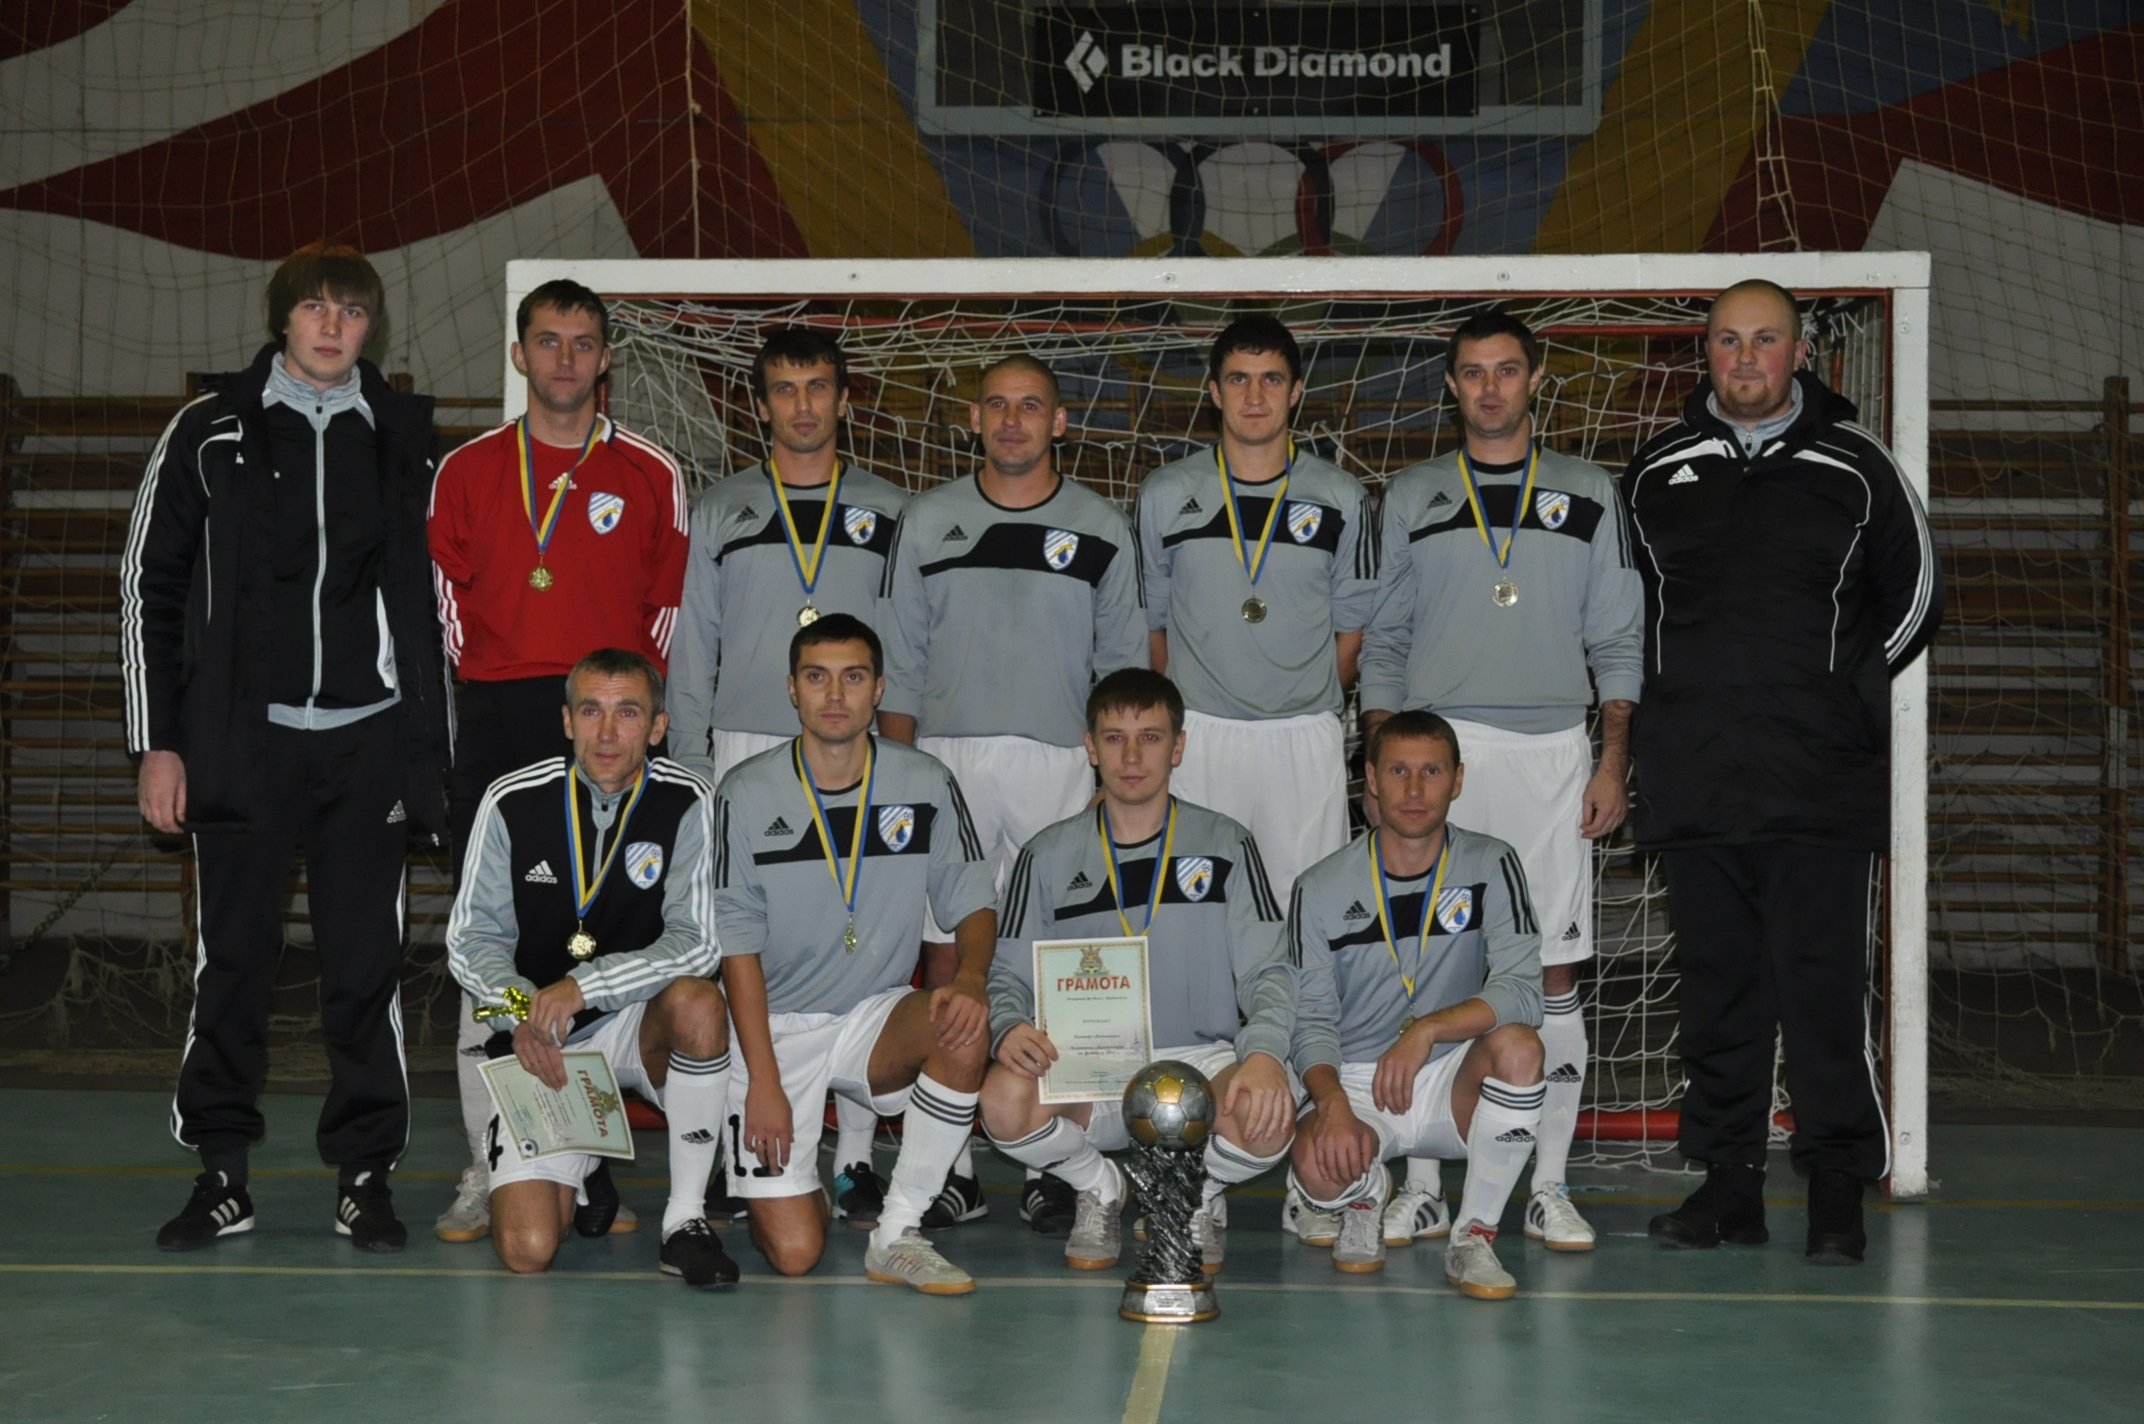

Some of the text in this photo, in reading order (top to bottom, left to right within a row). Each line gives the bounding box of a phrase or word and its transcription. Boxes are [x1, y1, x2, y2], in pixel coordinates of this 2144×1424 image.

[1121, 43, 1451, 78] Black Diamond
[764, 828, 794, 837] adidas
[525, 874, 558, 884] adidas
[1343, 911, 1371, 921] adidas
[1057, 976, 1131, 992] ГРАМОТА
[1546, 1074, 1582, 1083] adidas
[577, 1069, 608, 1138] ГРАМОТА
[1495, 1135, 1536, 1143] adidas
